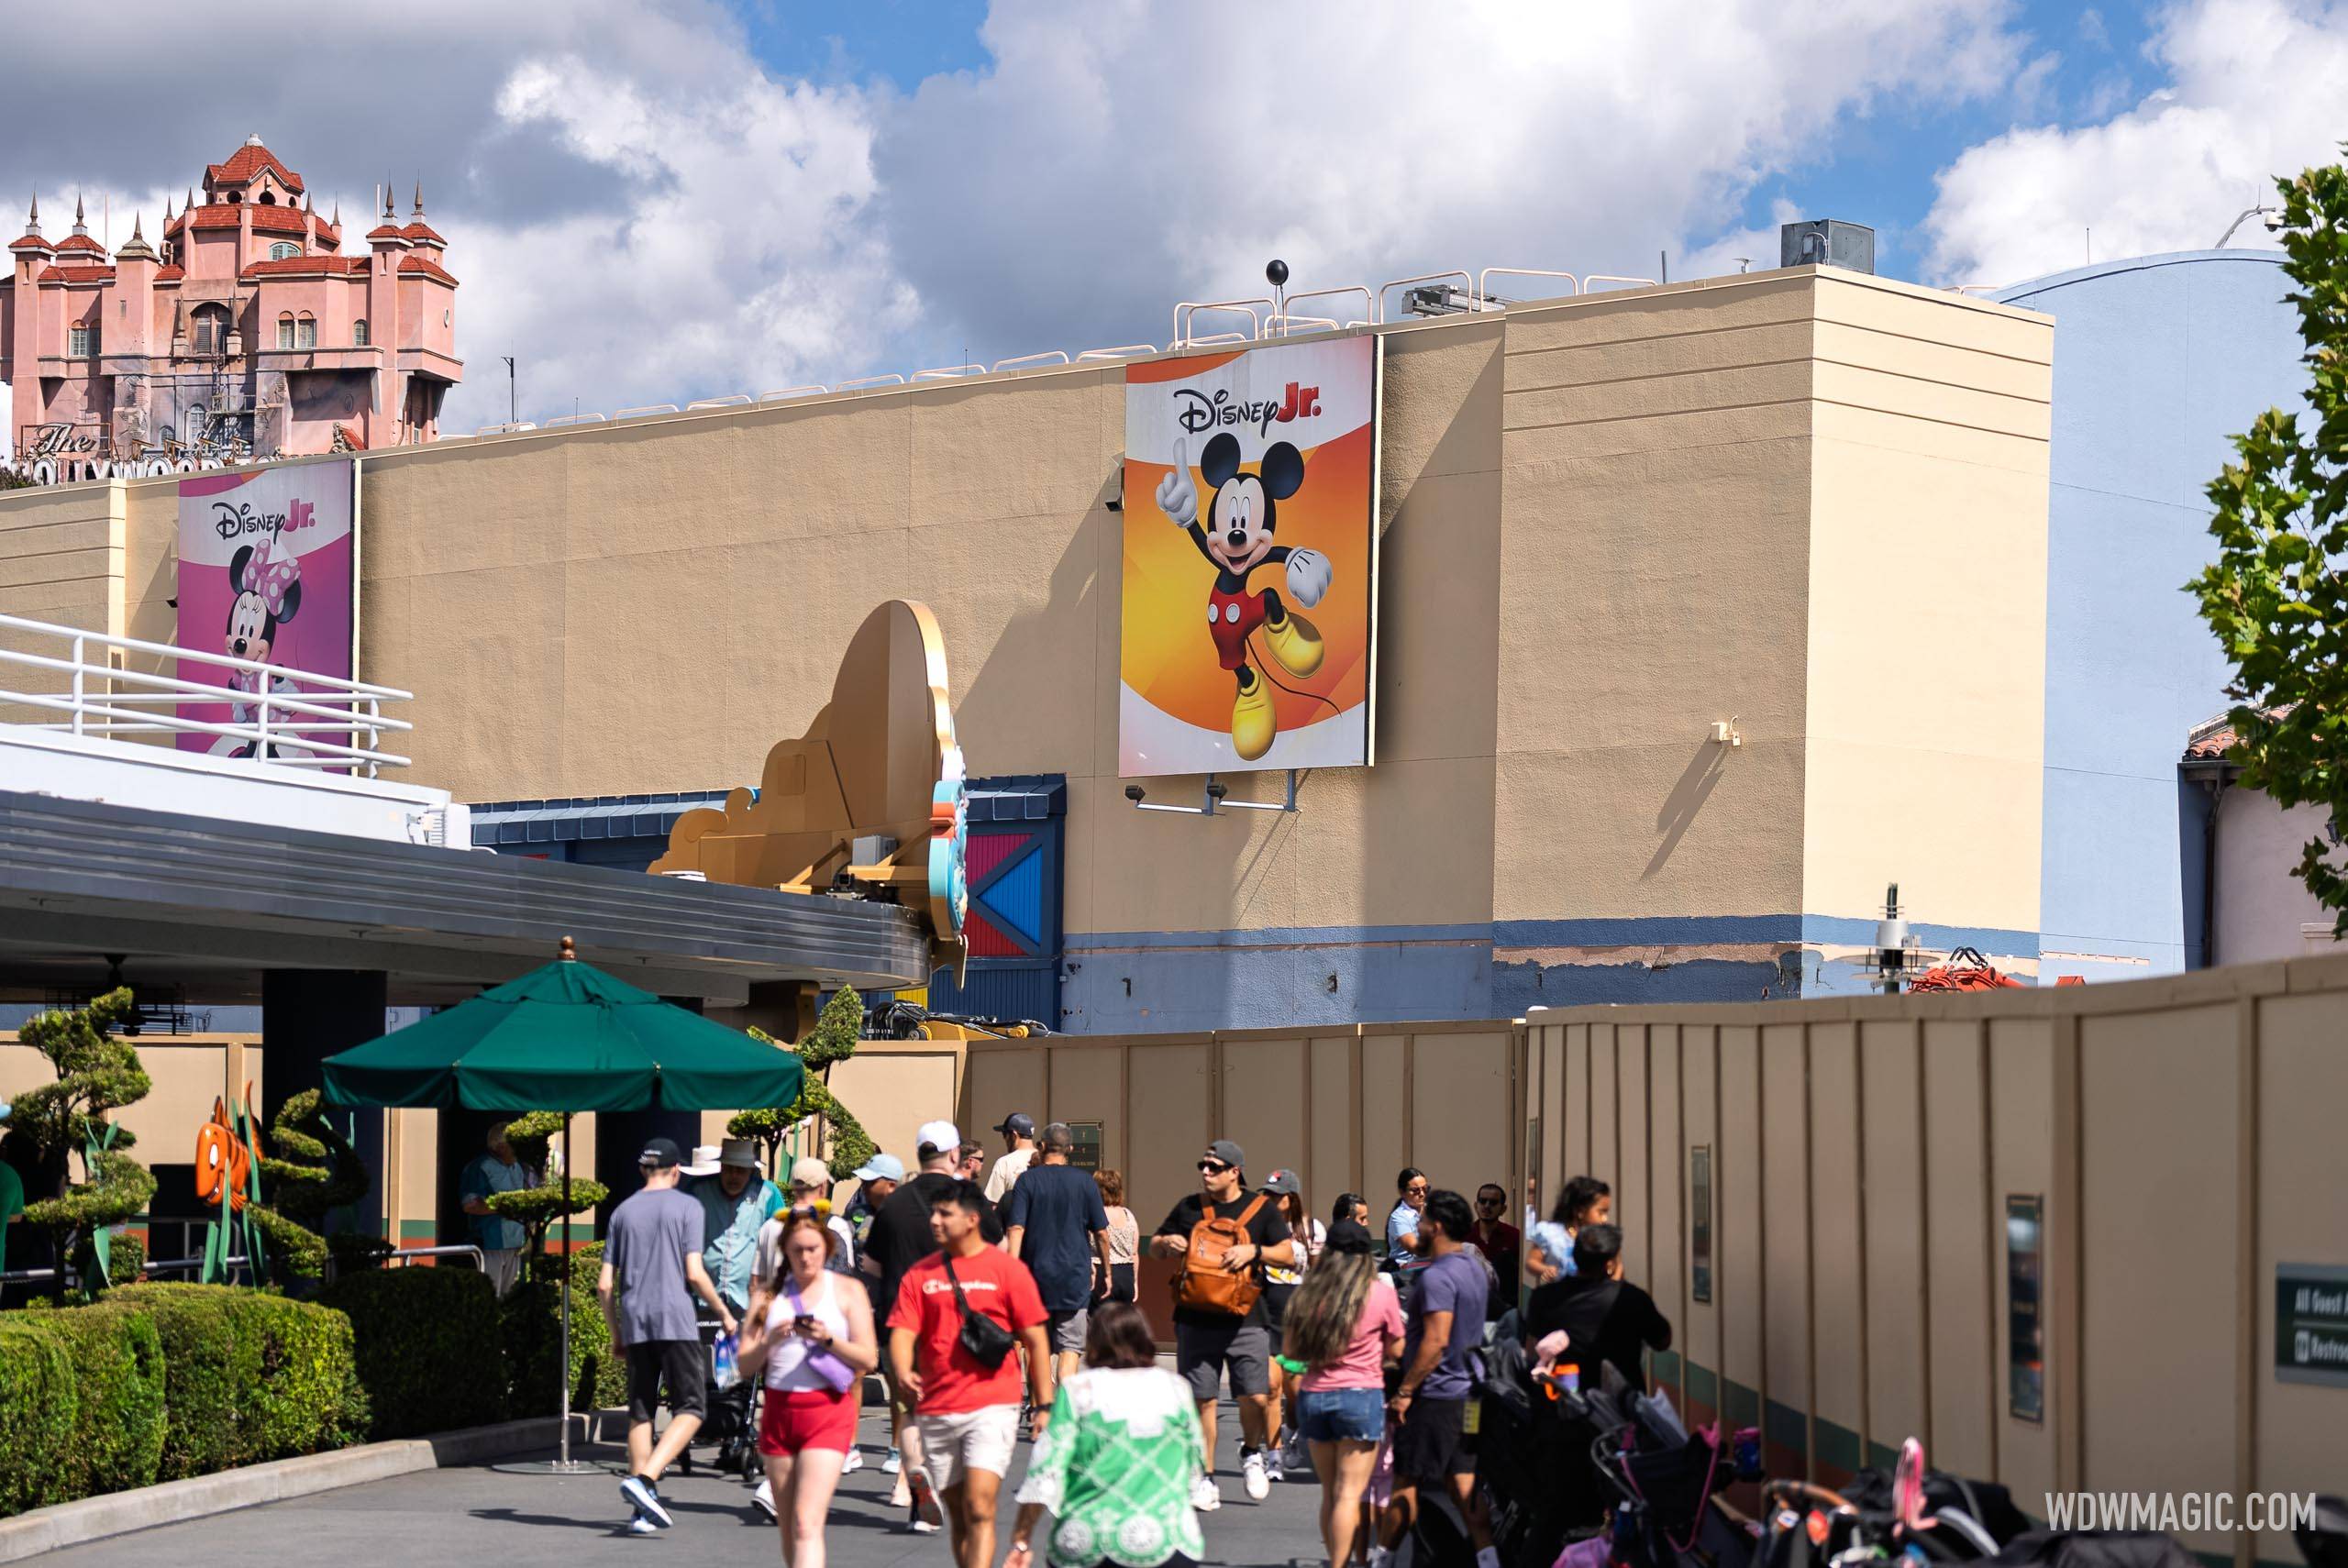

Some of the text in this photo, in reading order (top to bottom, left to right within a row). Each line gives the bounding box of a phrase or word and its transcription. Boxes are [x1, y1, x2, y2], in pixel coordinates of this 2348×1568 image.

[1173, 381, 1322, 438] Disney Jr.
[37, 422, 96, 453] The
[212, 498, 316, 545] Disney Jr.
[2295, 1287, 2310, 1312] All
